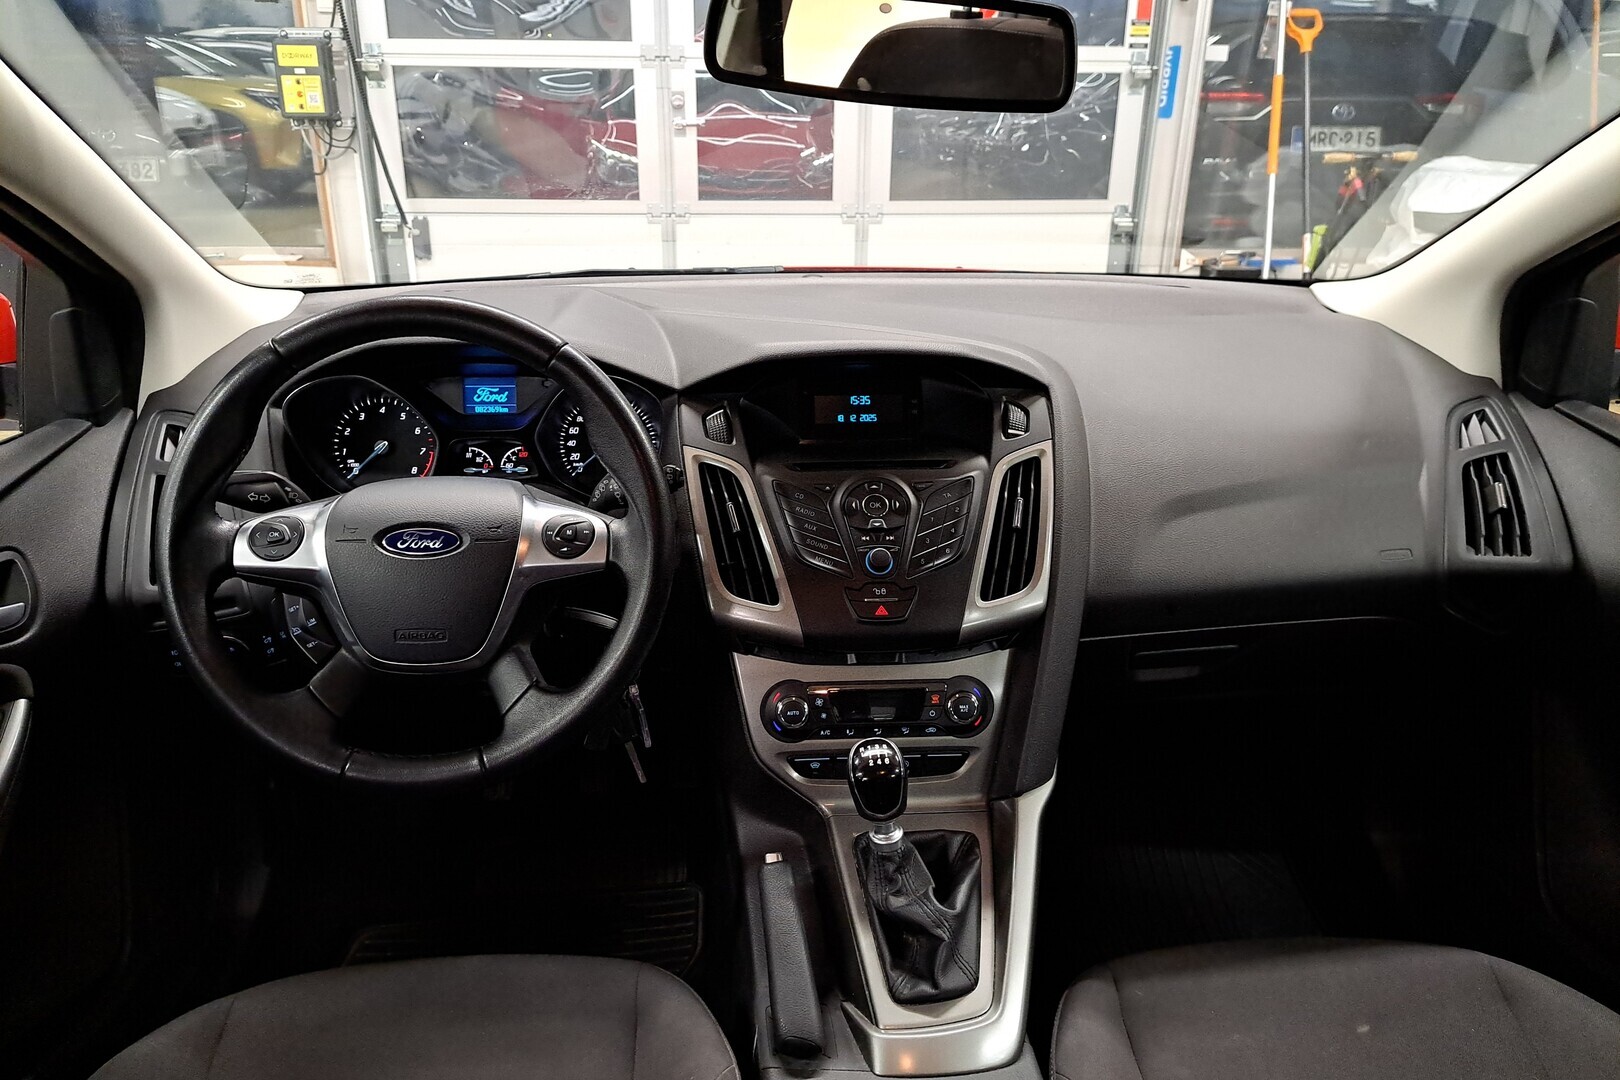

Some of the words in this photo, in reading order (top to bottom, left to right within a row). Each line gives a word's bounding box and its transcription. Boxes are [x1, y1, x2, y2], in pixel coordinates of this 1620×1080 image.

[473, 387, 508, 402] Ford
[850, 395, 871, 405] 15:35
[379, 406, 386, 414] 4
[359, 413, 365, 421] 3
[859, 414, 878, 422] 2025
[344, 427, 351, 436] 2
[414, 426, 421, 435] 6
[569, 426, 579, 434] 60
[342, 448, 347, 456] 1
[420, 447, 426, 455] 7
[570, 453, 580, 461] 20
[794, 492, 805, 500] CD
[795, 506, 816, 517] RADIO
[803, 523, 817, 531] AUX
[397, 530, 445, 549] Ford
[805, 538, 829, 550] SOUND
[814, 555, 834, 567] MENU
[398, 631, 445, 640] AIRBAG
